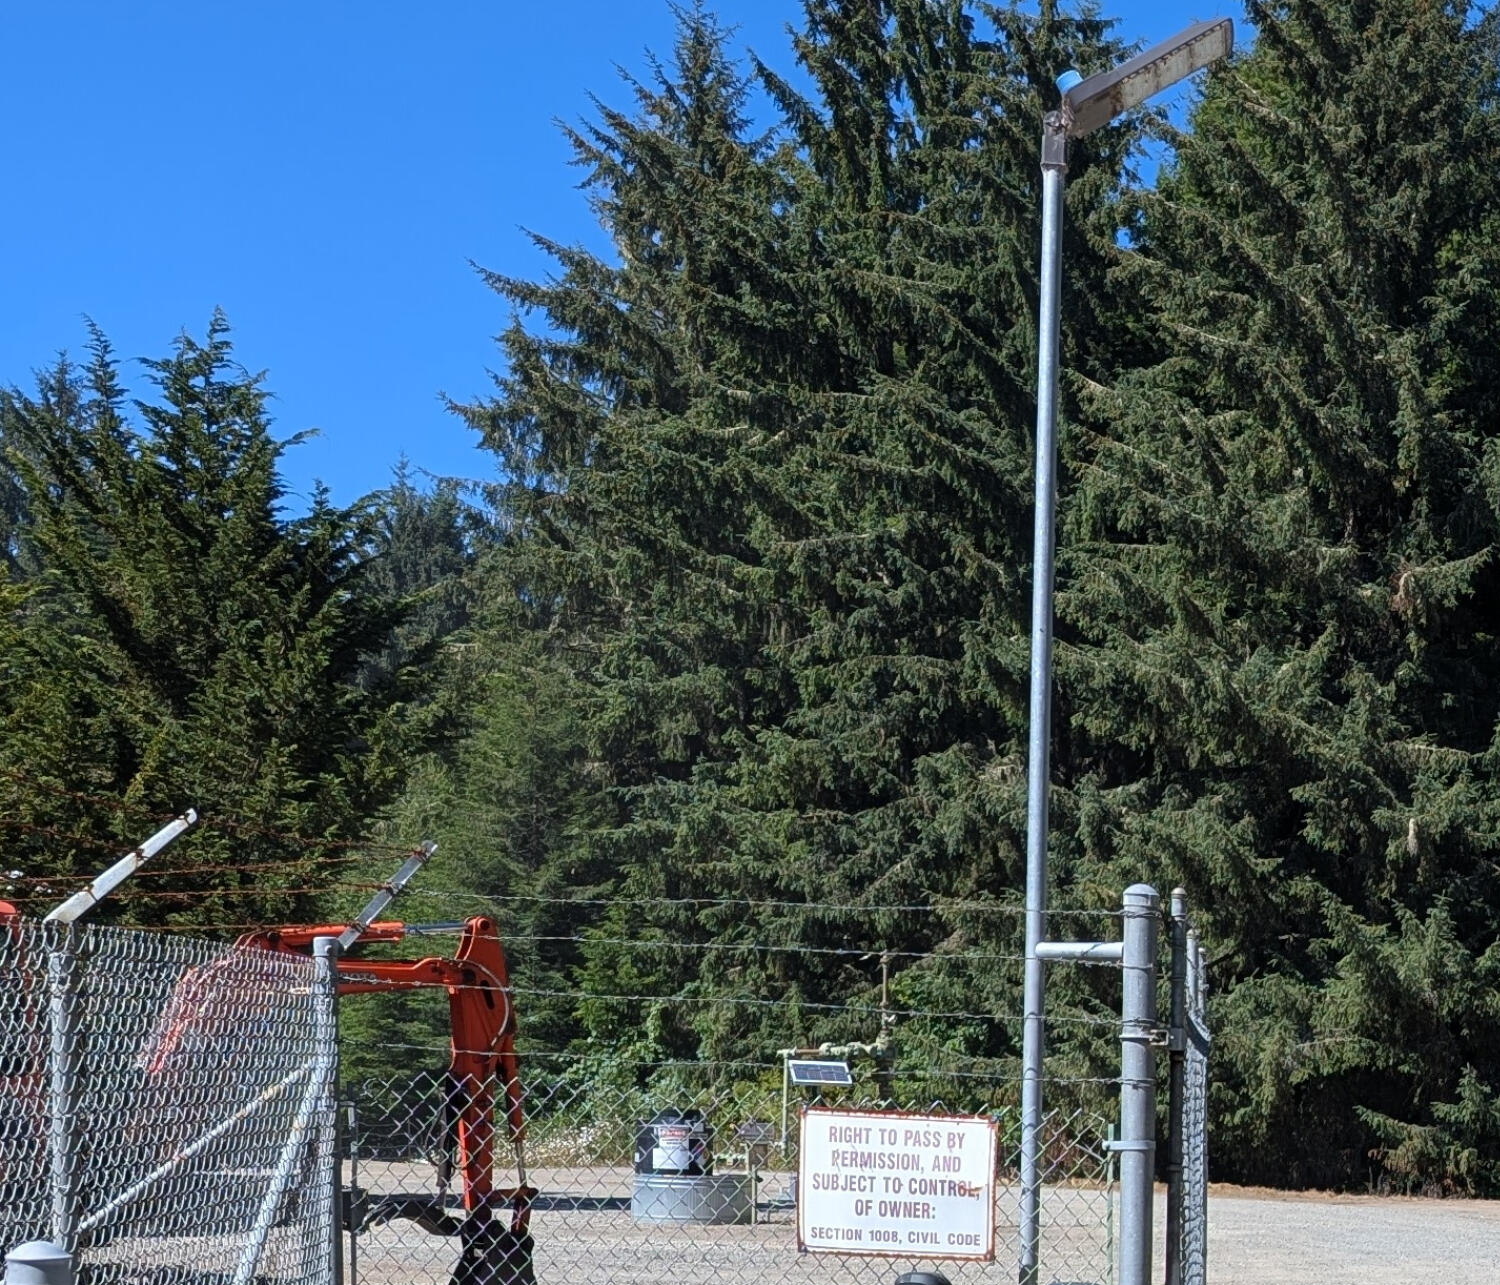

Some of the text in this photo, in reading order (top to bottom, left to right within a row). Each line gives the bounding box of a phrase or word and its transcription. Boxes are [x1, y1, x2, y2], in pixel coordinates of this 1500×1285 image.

[829, 1126, 965, 1149] RIGHT TO PASS BY
[832, 1150, 961, 1173] PERMISSION, AND
[812, 1173, 876, 1193] SUBJECT
[884, 1177, 900, 1194] TO
[855, 1199, 936, 1219] OF OWNER:
[811, 1227, 980, 1246] SECTION 1008, CIVIL CODE
